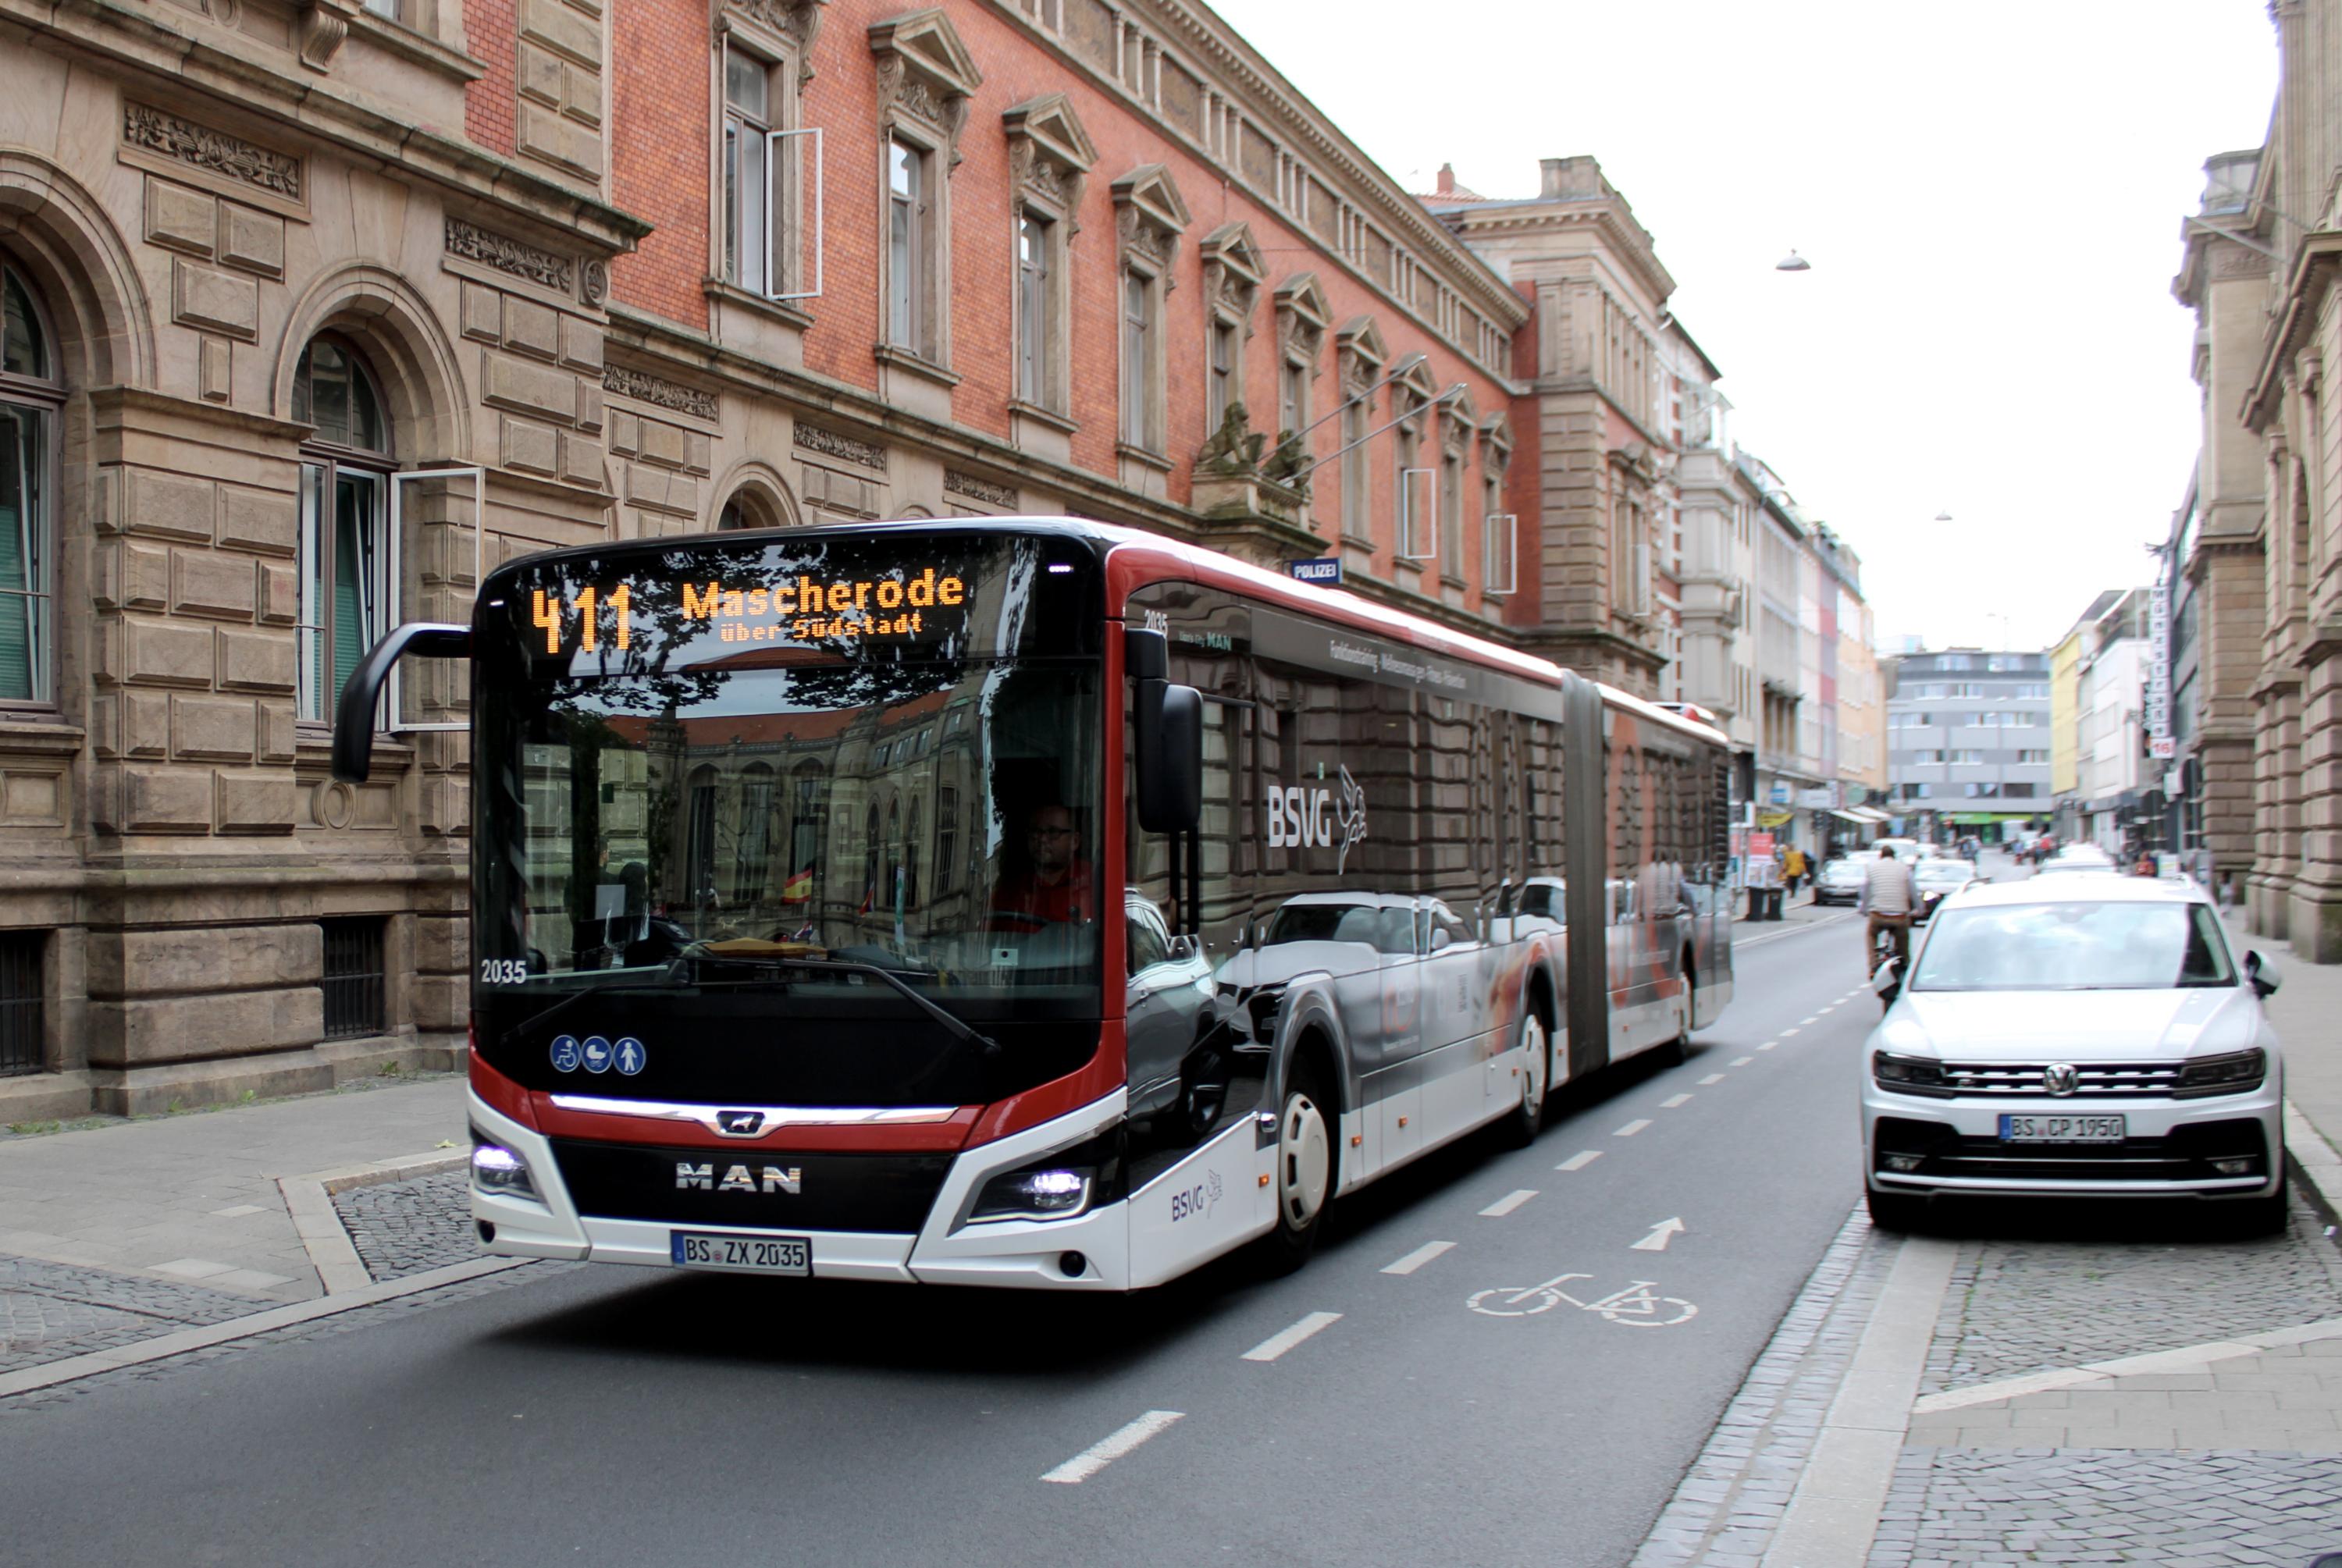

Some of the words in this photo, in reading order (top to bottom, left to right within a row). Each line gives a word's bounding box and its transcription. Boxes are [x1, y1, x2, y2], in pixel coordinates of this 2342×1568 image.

[1294, 564, 1337, 579] POLIZEI
[532, 584, 631, 654] 411
[682, 567, 963, 620] Mascherode
[720, 623, 781, 642] über
[792, 612, 923, 639] Südstadt
[1207, 631, 1232, 651] MAN
[2152, 741, 2171, 756] 16
[1268, 785, 1331, 848] BSVG
[480, 958, 527, 984] 2035
[2011, 1118, 2034, 1136] BS
[2048, 1118, 2071, 1136] CP
[675, 1162, 802, 1194] MAN
[1172, 1184, 1204, 1222] BSVG
[685, 1239, 710, 1262] BS
[724, 1241, 750, 1264] ZX
[755, 1243, 805, 1267] 2035
